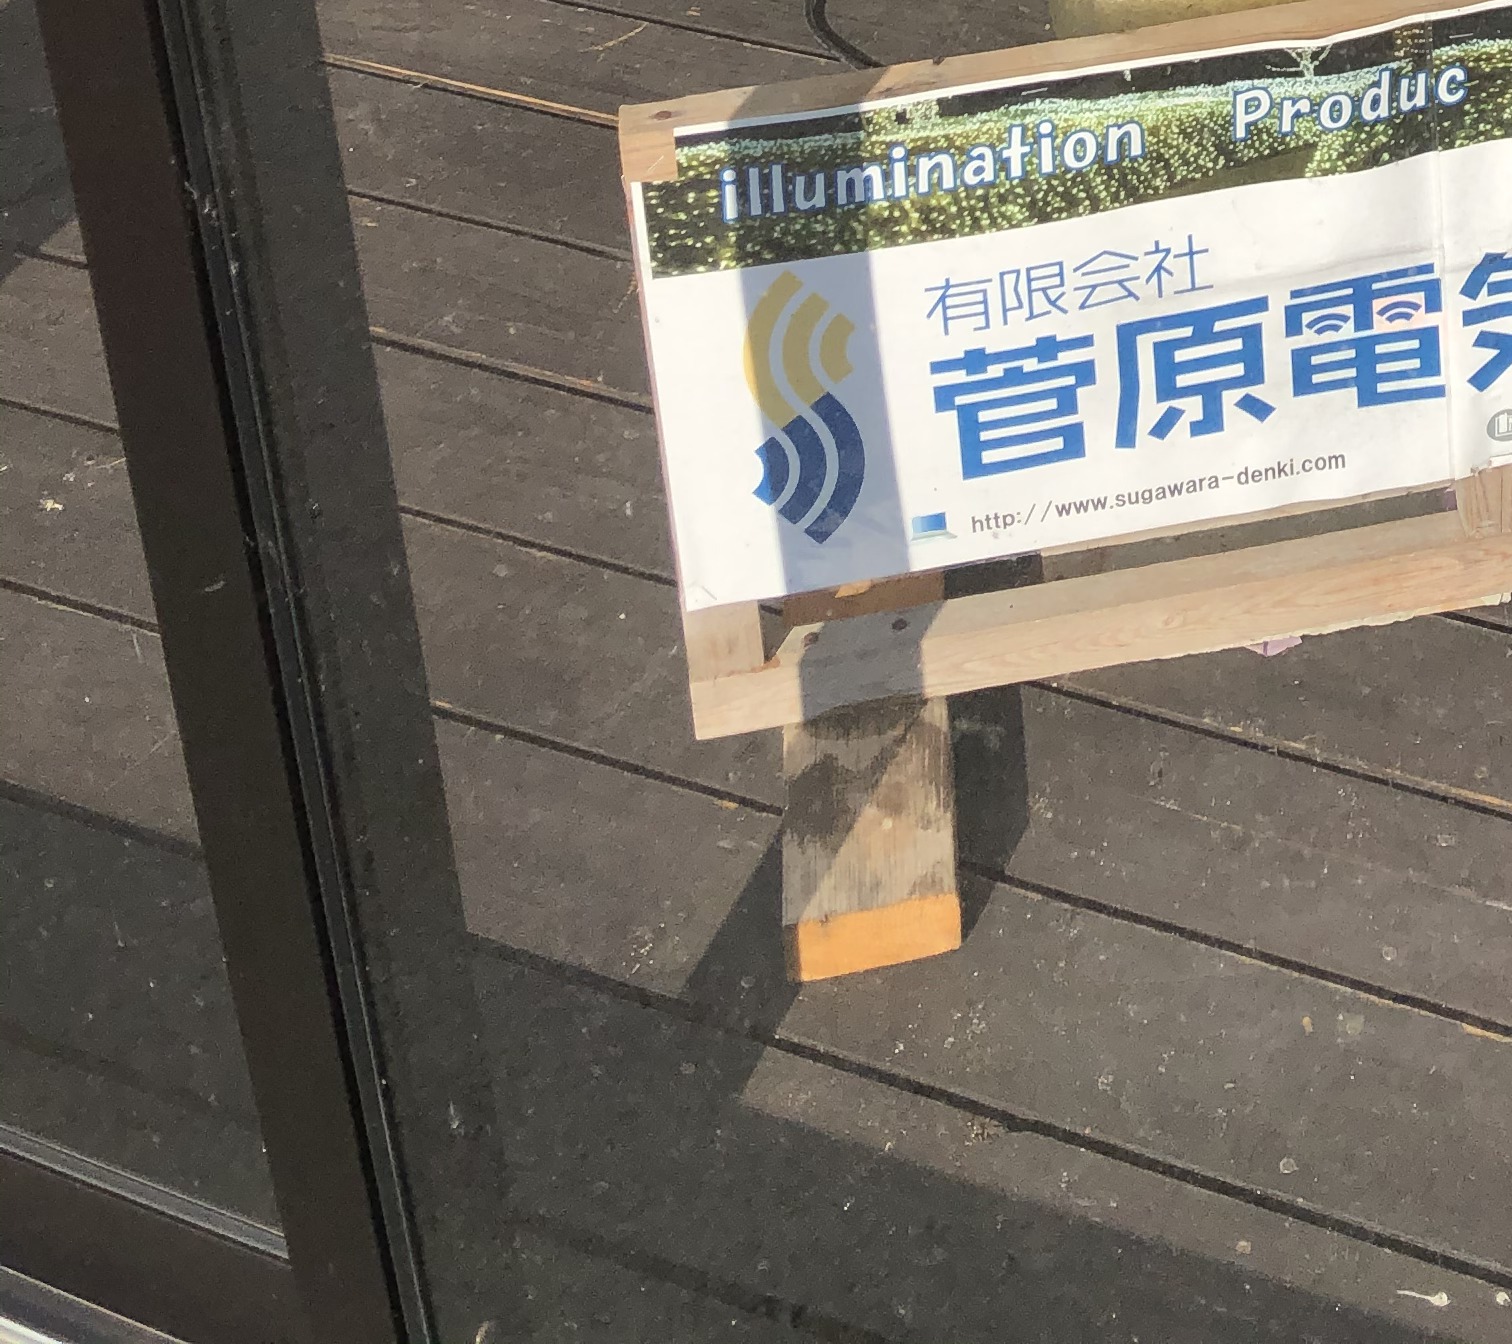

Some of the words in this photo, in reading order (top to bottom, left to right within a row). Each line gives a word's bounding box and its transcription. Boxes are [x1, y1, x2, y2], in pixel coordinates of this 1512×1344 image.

[720, 115, 1146, 224] illumination
[1231, 59, 1472, 143] Produc
[923, 233, 1215, 336] 有限会社
[970, 450, 1348, 535] http://www.sugawara-denki.com
